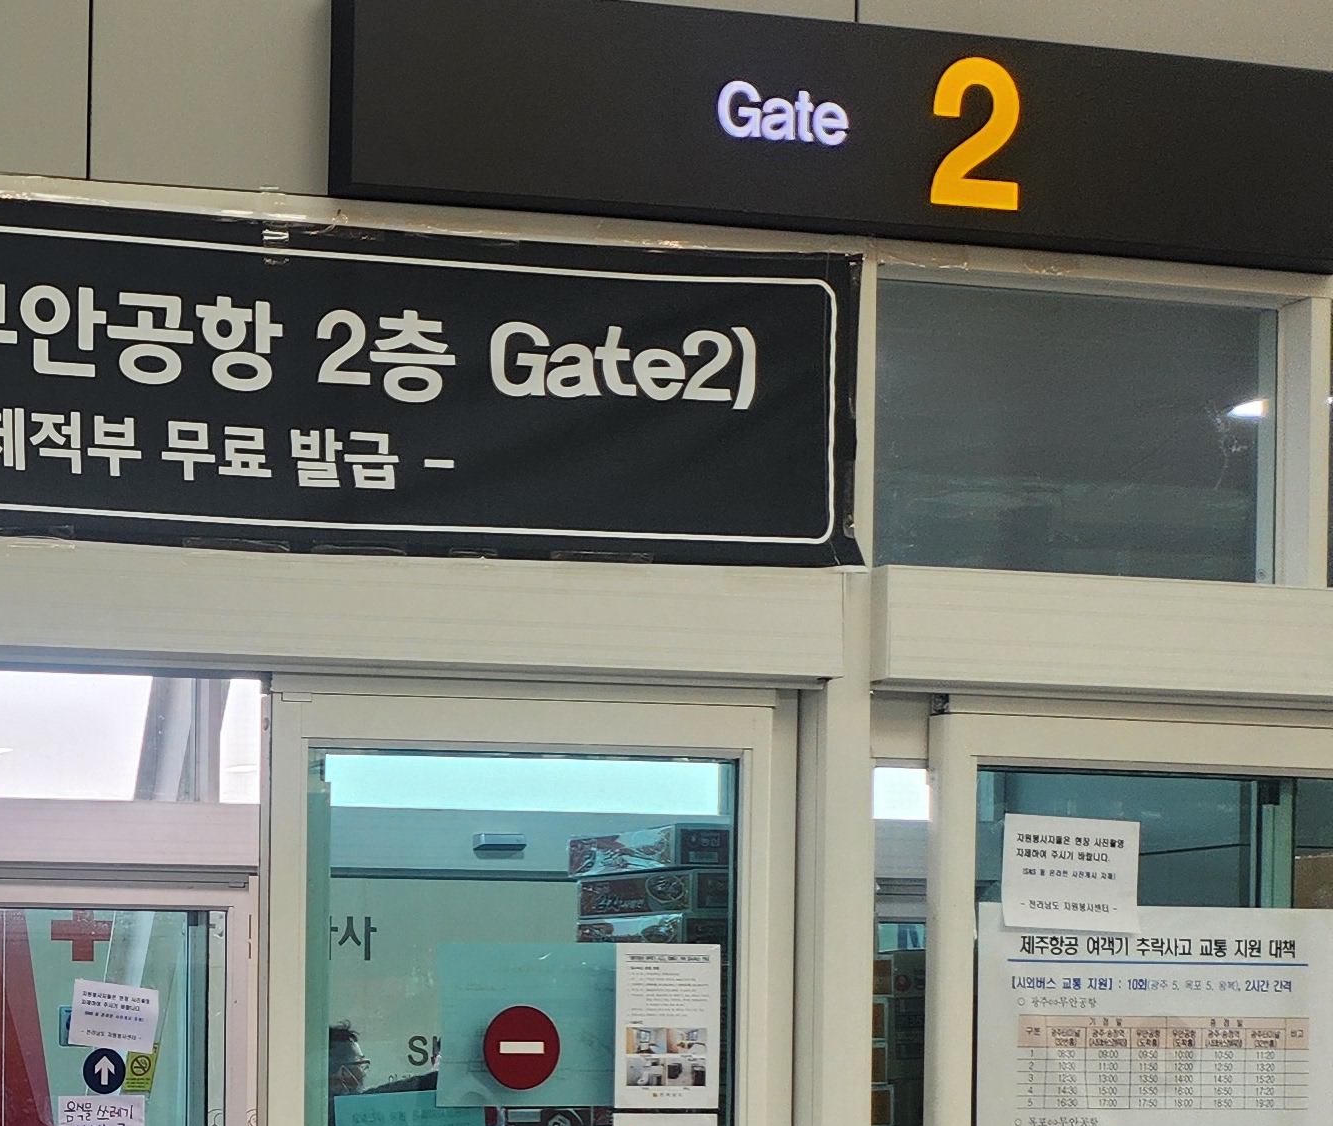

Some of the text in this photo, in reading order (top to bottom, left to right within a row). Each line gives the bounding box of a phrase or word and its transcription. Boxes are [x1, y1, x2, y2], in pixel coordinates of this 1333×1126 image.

[718, 55, 1021, 211] Gate 2
[317, 308, 458, 402] 2층
[490, 319, 757, 411] Gate2)
[160, 425, 273, 481] 무료
[288, 427, 399, 489] 발급
[1020, 935, 1296, 959] 제주항공 여객기 추락사고 교통 지원 대책
[1062, 977, 1081, 991] 교통
[64, 1101, 133, 1122] 음식물 쓰레기
